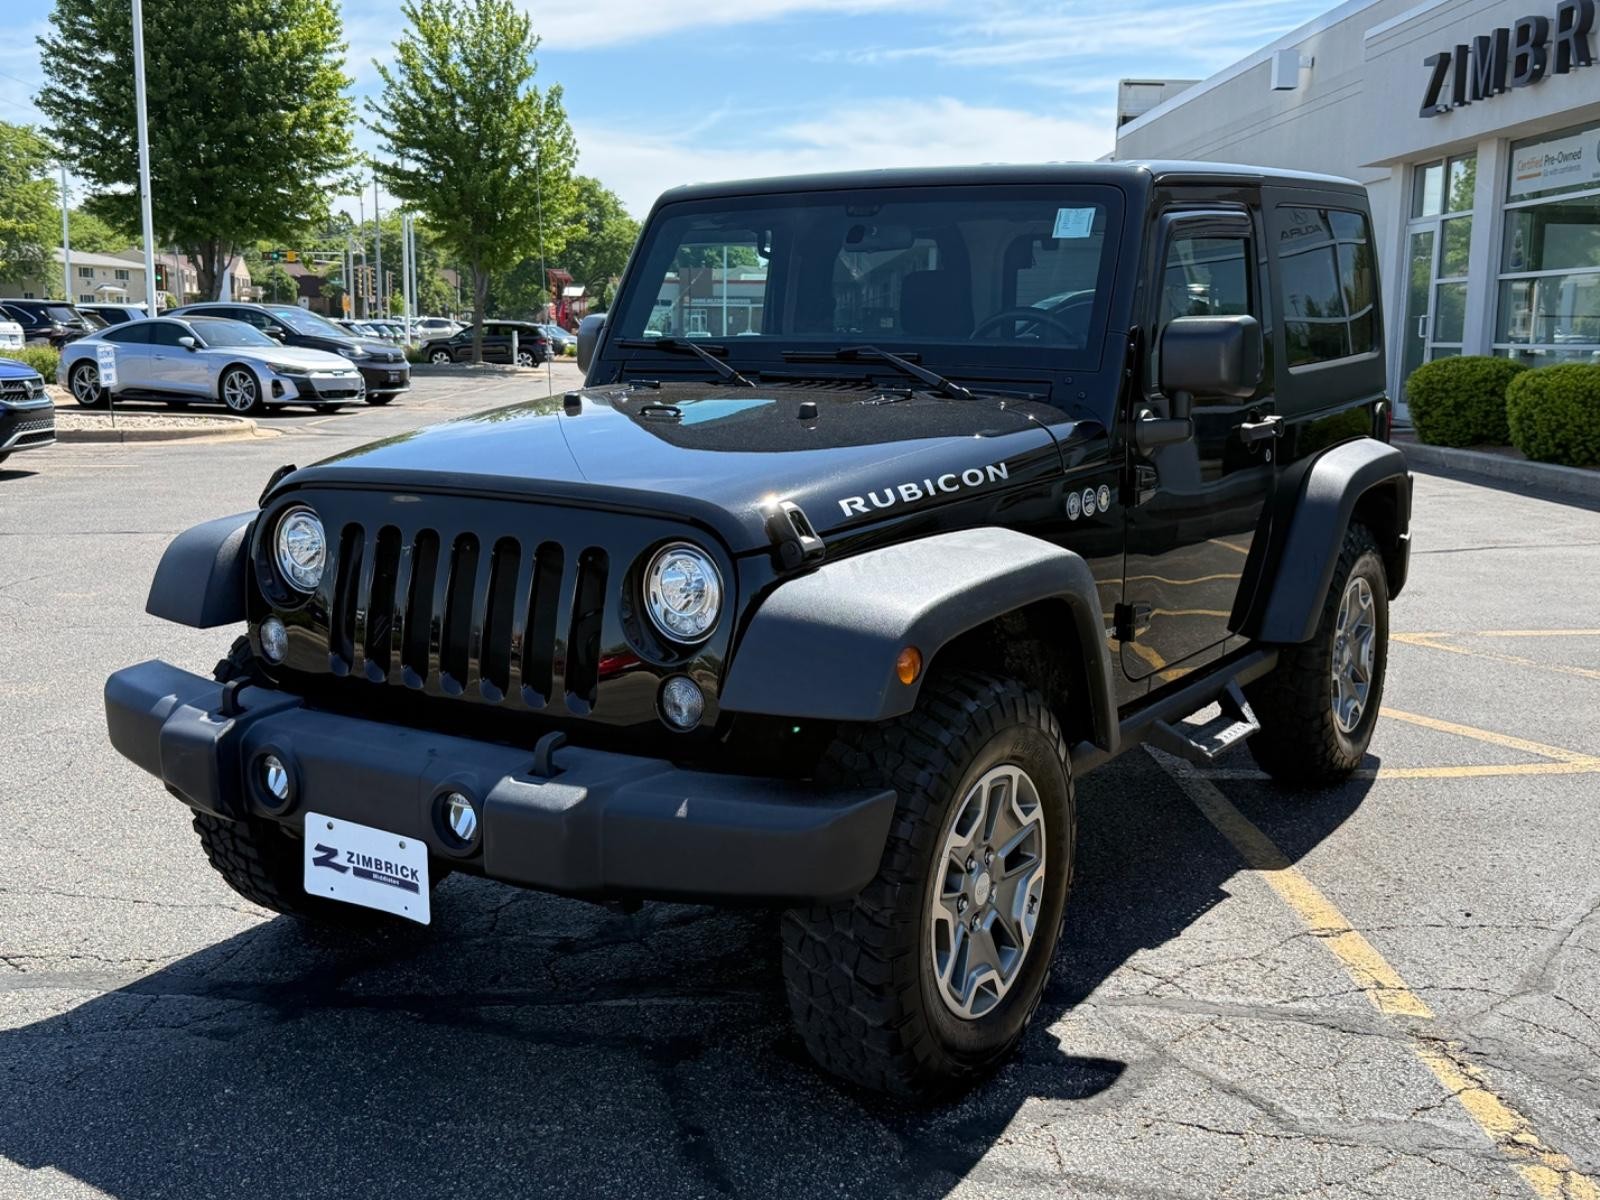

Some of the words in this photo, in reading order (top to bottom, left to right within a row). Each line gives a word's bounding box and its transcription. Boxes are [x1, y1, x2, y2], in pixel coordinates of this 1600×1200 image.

[1419, 0, 1595, 118] ZIMBR
[1544, 148, 1582, 166] Pre-Owned
[838, 462, 1009, 517] RUBICON
[347, 851, 419, 881] ZIMBRICK
